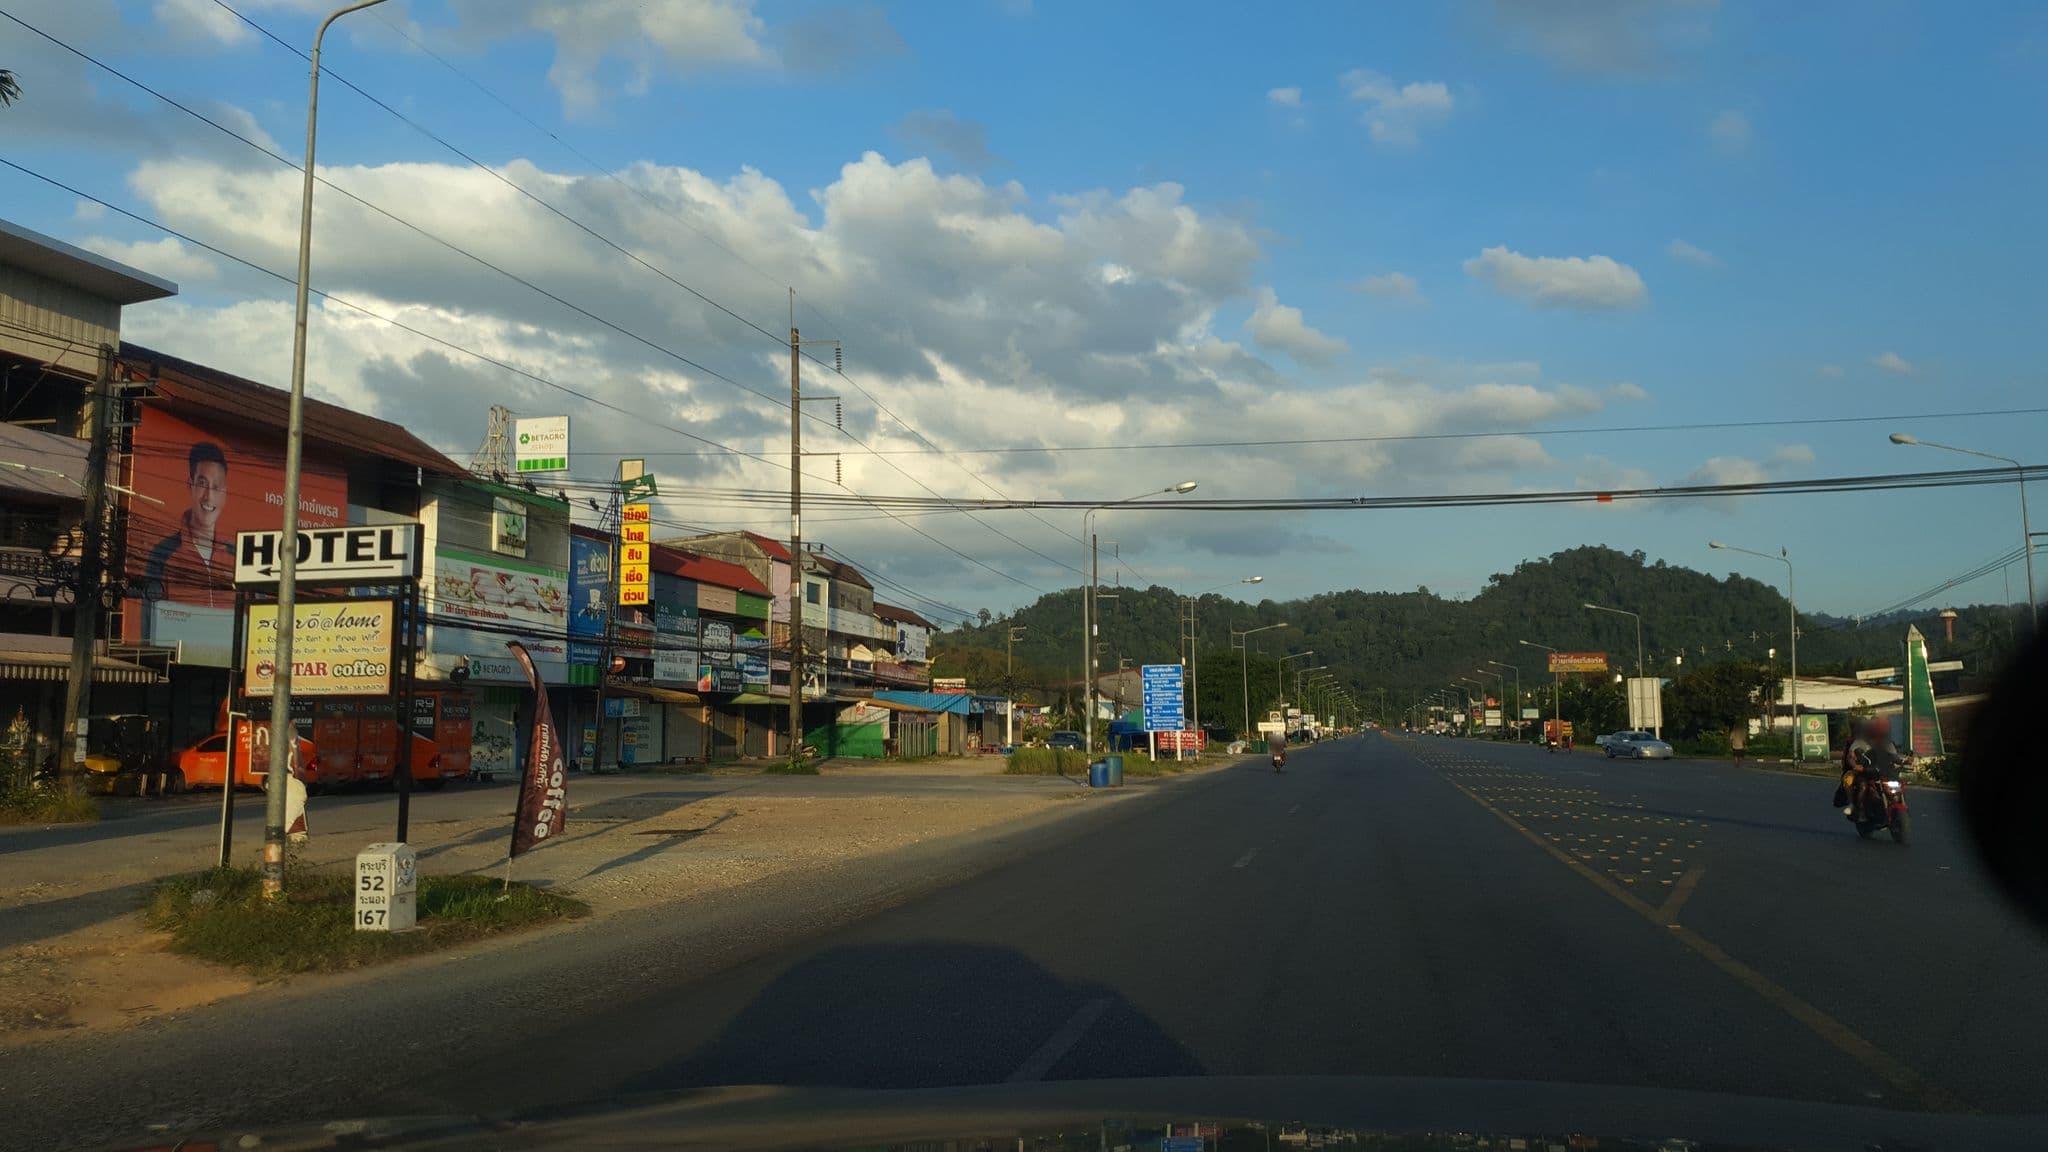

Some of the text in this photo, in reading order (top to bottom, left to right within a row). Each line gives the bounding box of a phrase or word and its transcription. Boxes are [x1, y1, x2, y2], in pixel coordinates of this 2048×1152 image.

[531, 433, 565, 442] BETAGRO
[242, 529, 408, 566] HOTEL
[333, 659, 387, 678] coffee
[482, 664, 511, 674] BETAGRO
[534, 757, 566, 838] coffee
[360, 859, 386, 874] คุระบุรี
[361, 876, 385, 891] 52
[360, 896, 386, 904] ระนอง
[358, 910, 387, 926] 167
